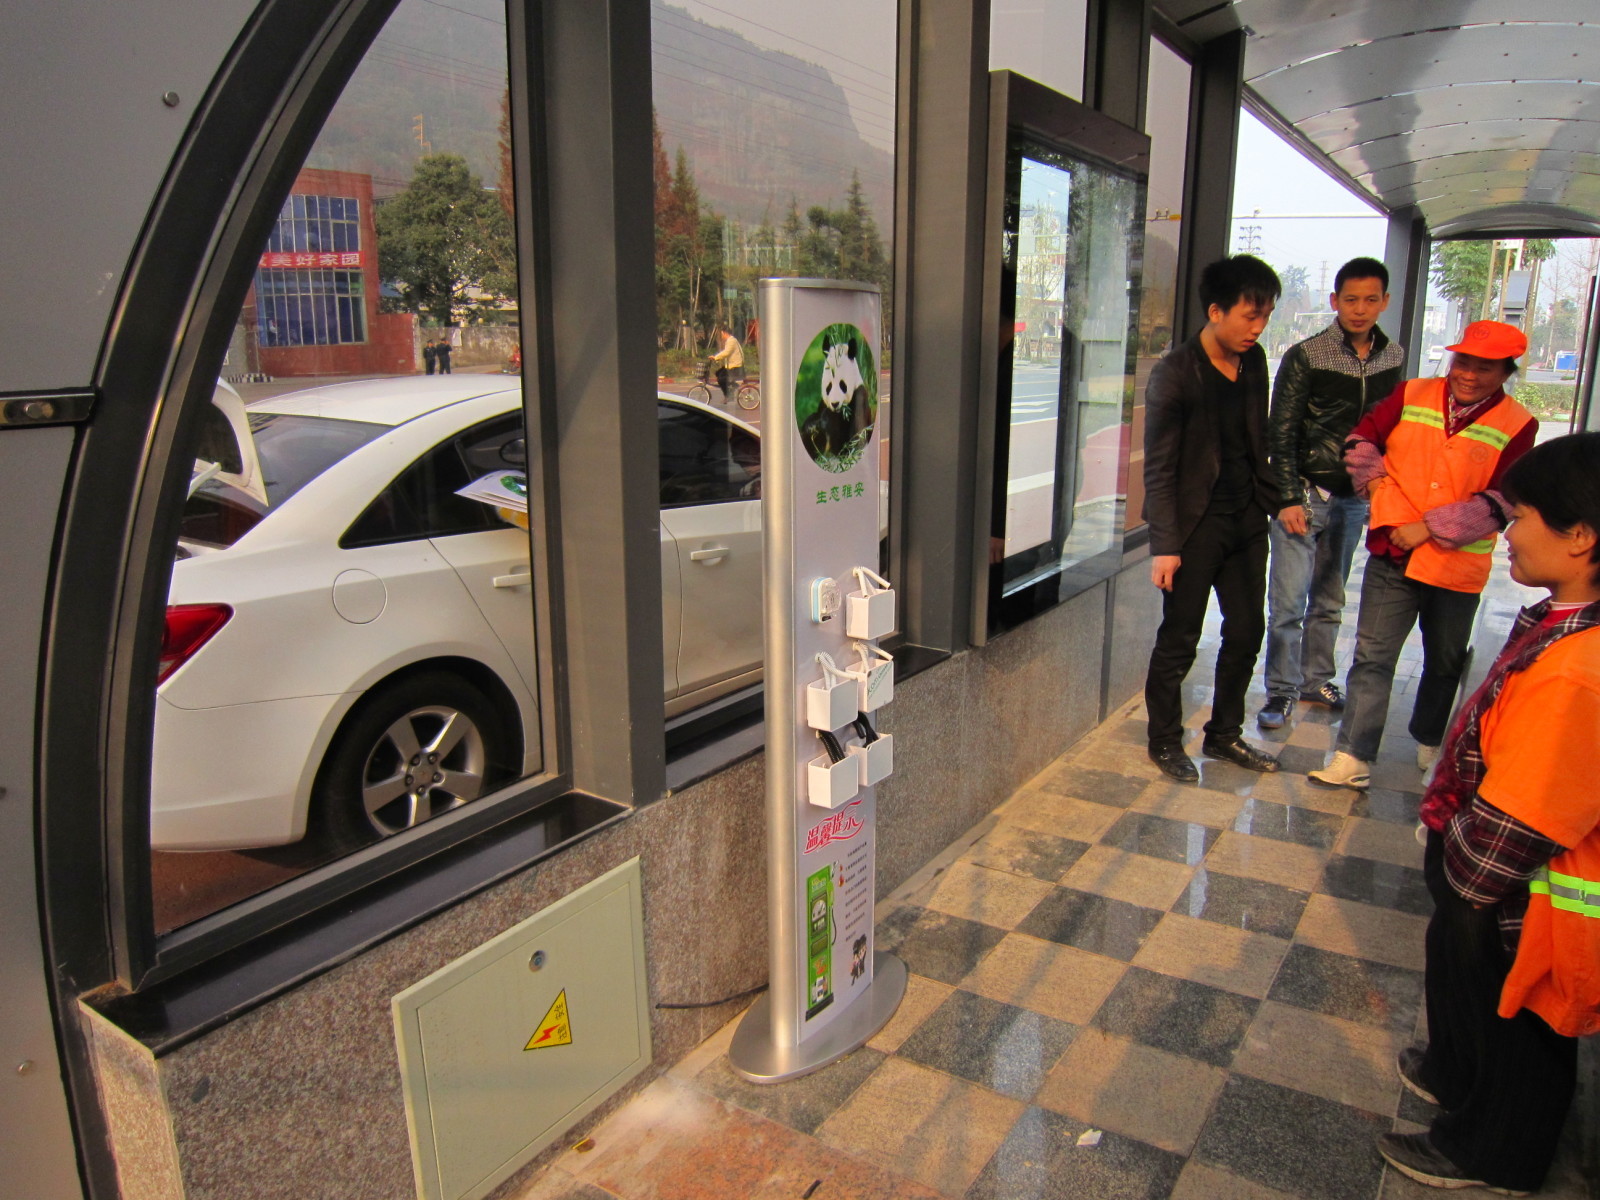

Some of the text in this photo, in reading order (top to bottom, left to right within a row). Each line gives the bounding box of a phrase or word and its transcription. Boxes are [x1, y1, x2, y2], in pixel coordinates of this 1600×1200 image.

[816, 482, 864, 504] 生态雅安
[804, 801, 864, 853] 温馨提示
